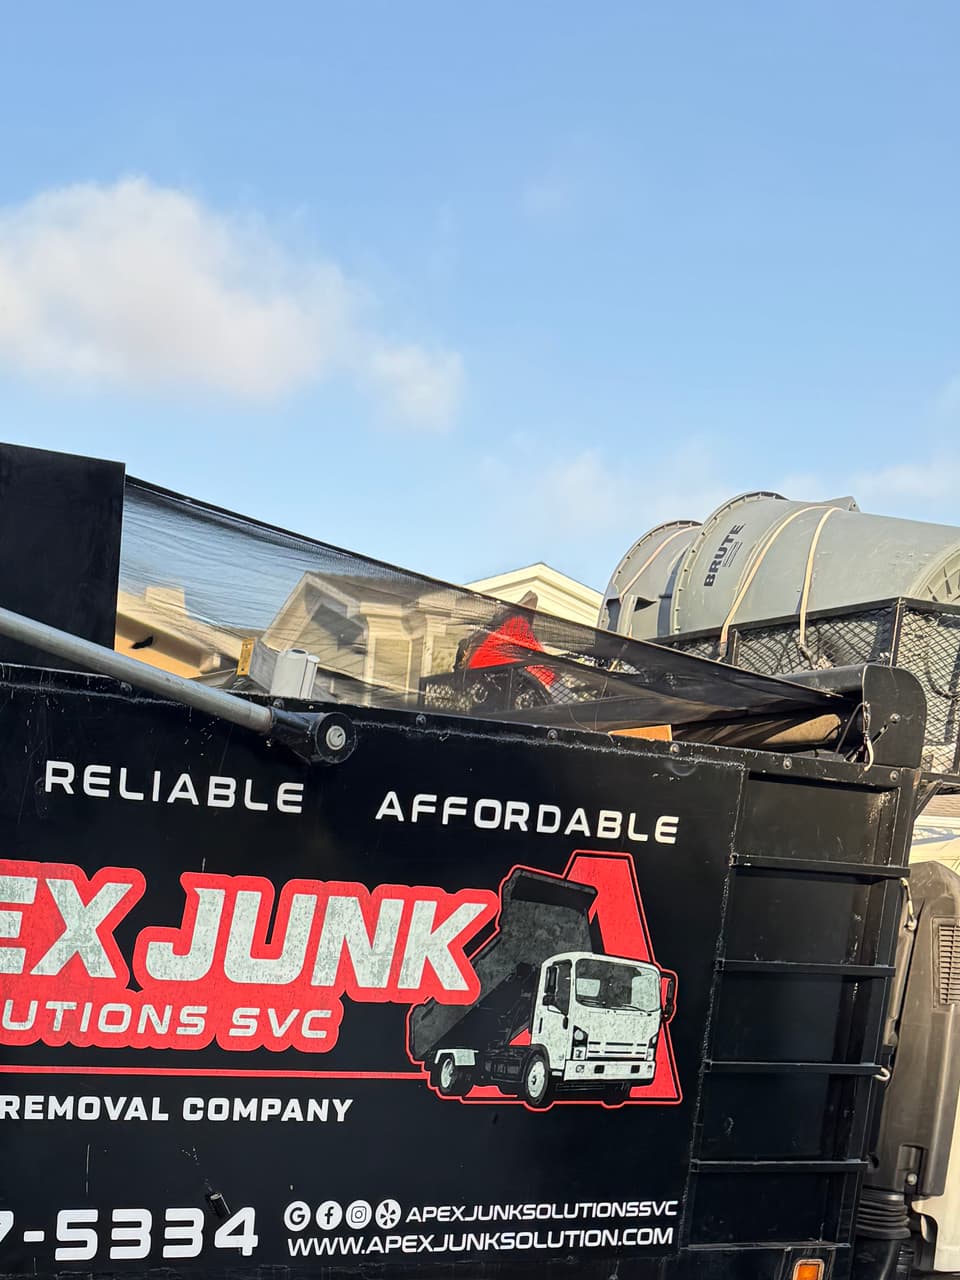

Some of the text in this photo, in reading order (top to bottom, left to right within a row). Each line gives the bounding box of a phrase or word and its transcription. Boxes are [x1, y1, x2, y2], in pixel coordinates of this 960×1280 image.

[704, 523, 746, 587] BRUTE
[44, 760, 304, 814] RELIABLE
[375, 790, 680, 844] AFFORDABLE
[146, 887, 488, 992] JUNK
[228, 1006, 333, 1039] SVC
[182, 1097, 354, 1122] COMPANY
[405, 1200, 679, 1223] APEXJUNKSOLUTIONSSVC
[286, 1227, 674, 1257] WWW.APEXJUNKSOLUTION.COM
